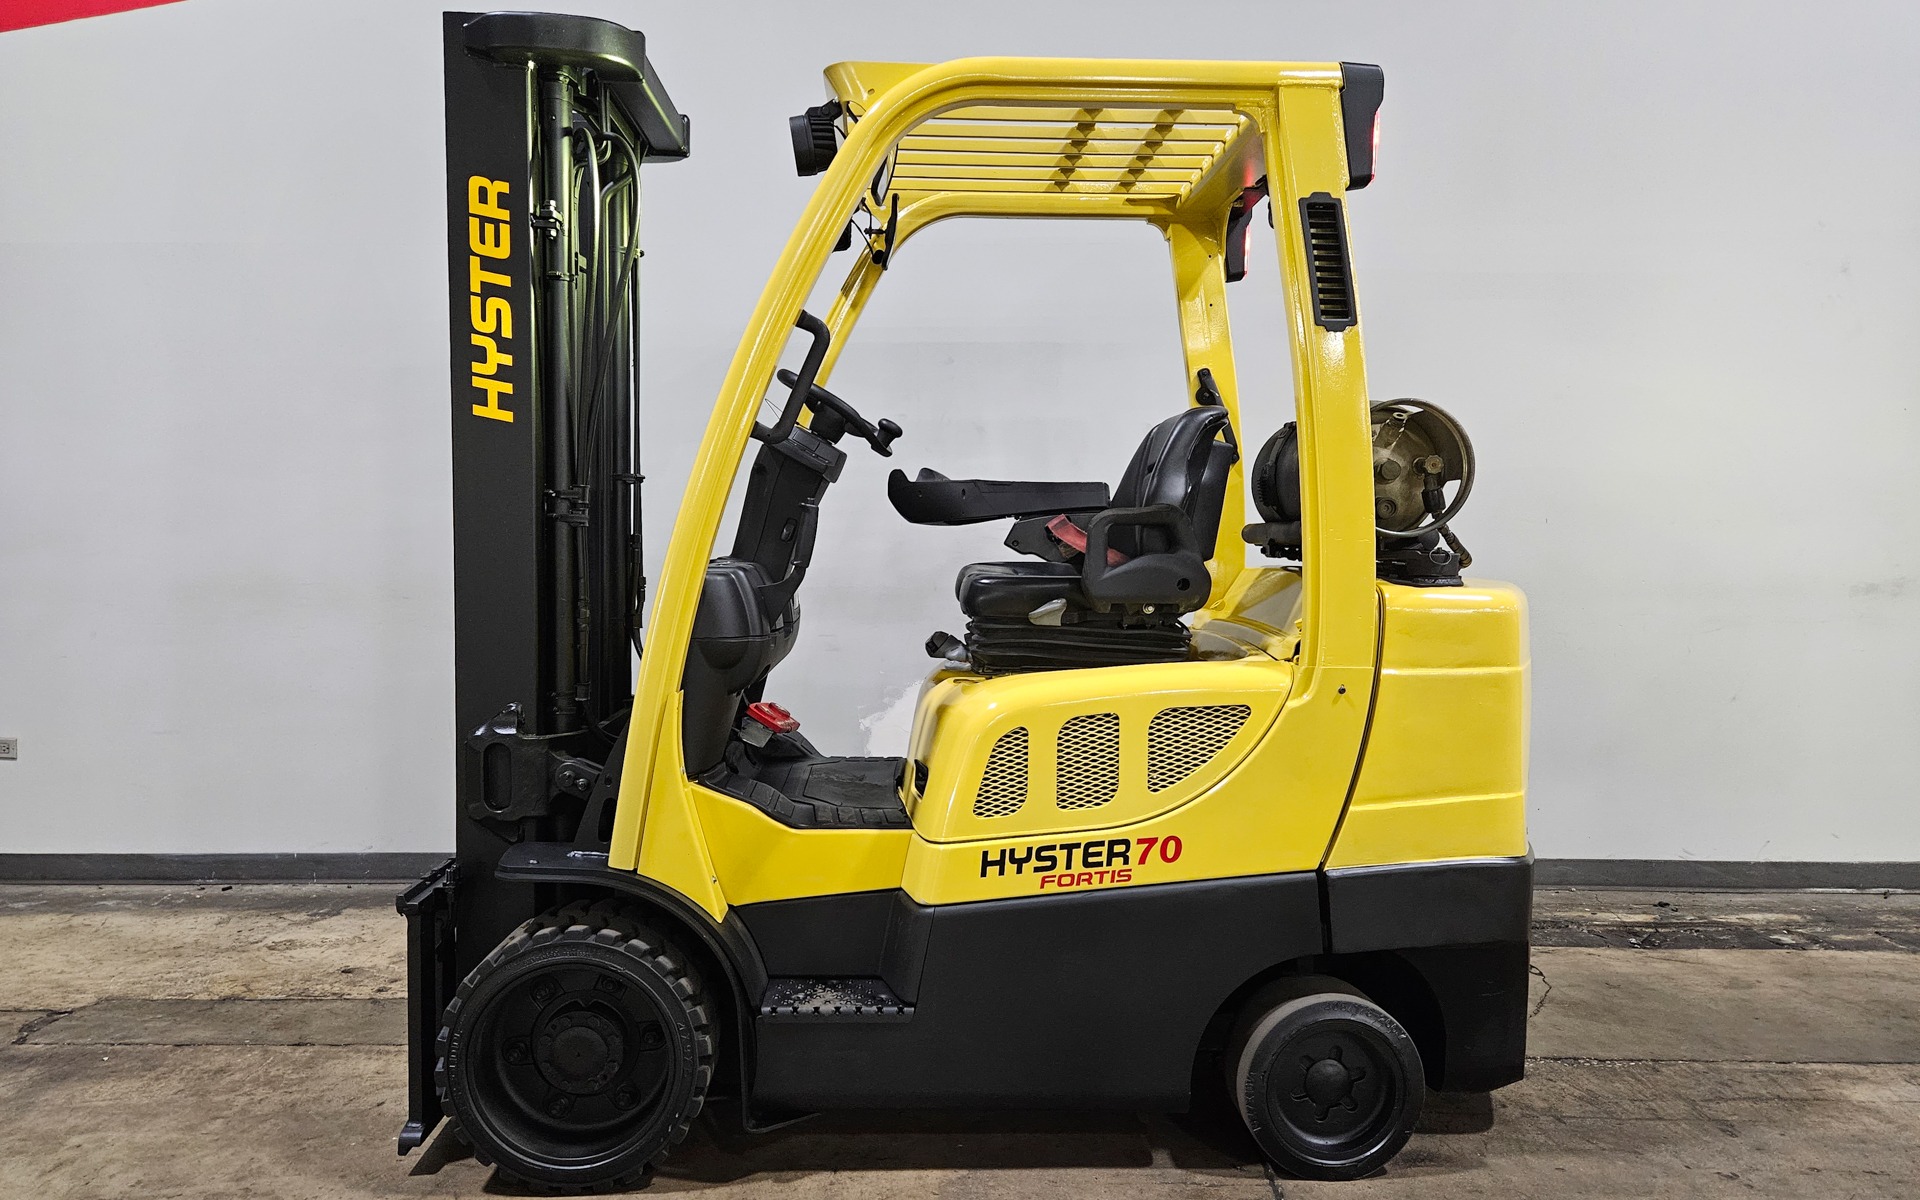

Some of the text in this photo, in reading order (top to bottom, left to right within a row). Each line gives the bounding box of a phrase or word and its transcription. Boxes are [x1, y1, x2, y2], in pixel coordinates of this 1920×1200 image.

[468, 175, 514, 423] HYSTER
[980, 835, 1183, 878] HYSTER 70
[1039, 868, 1133, 889] FORTIS
